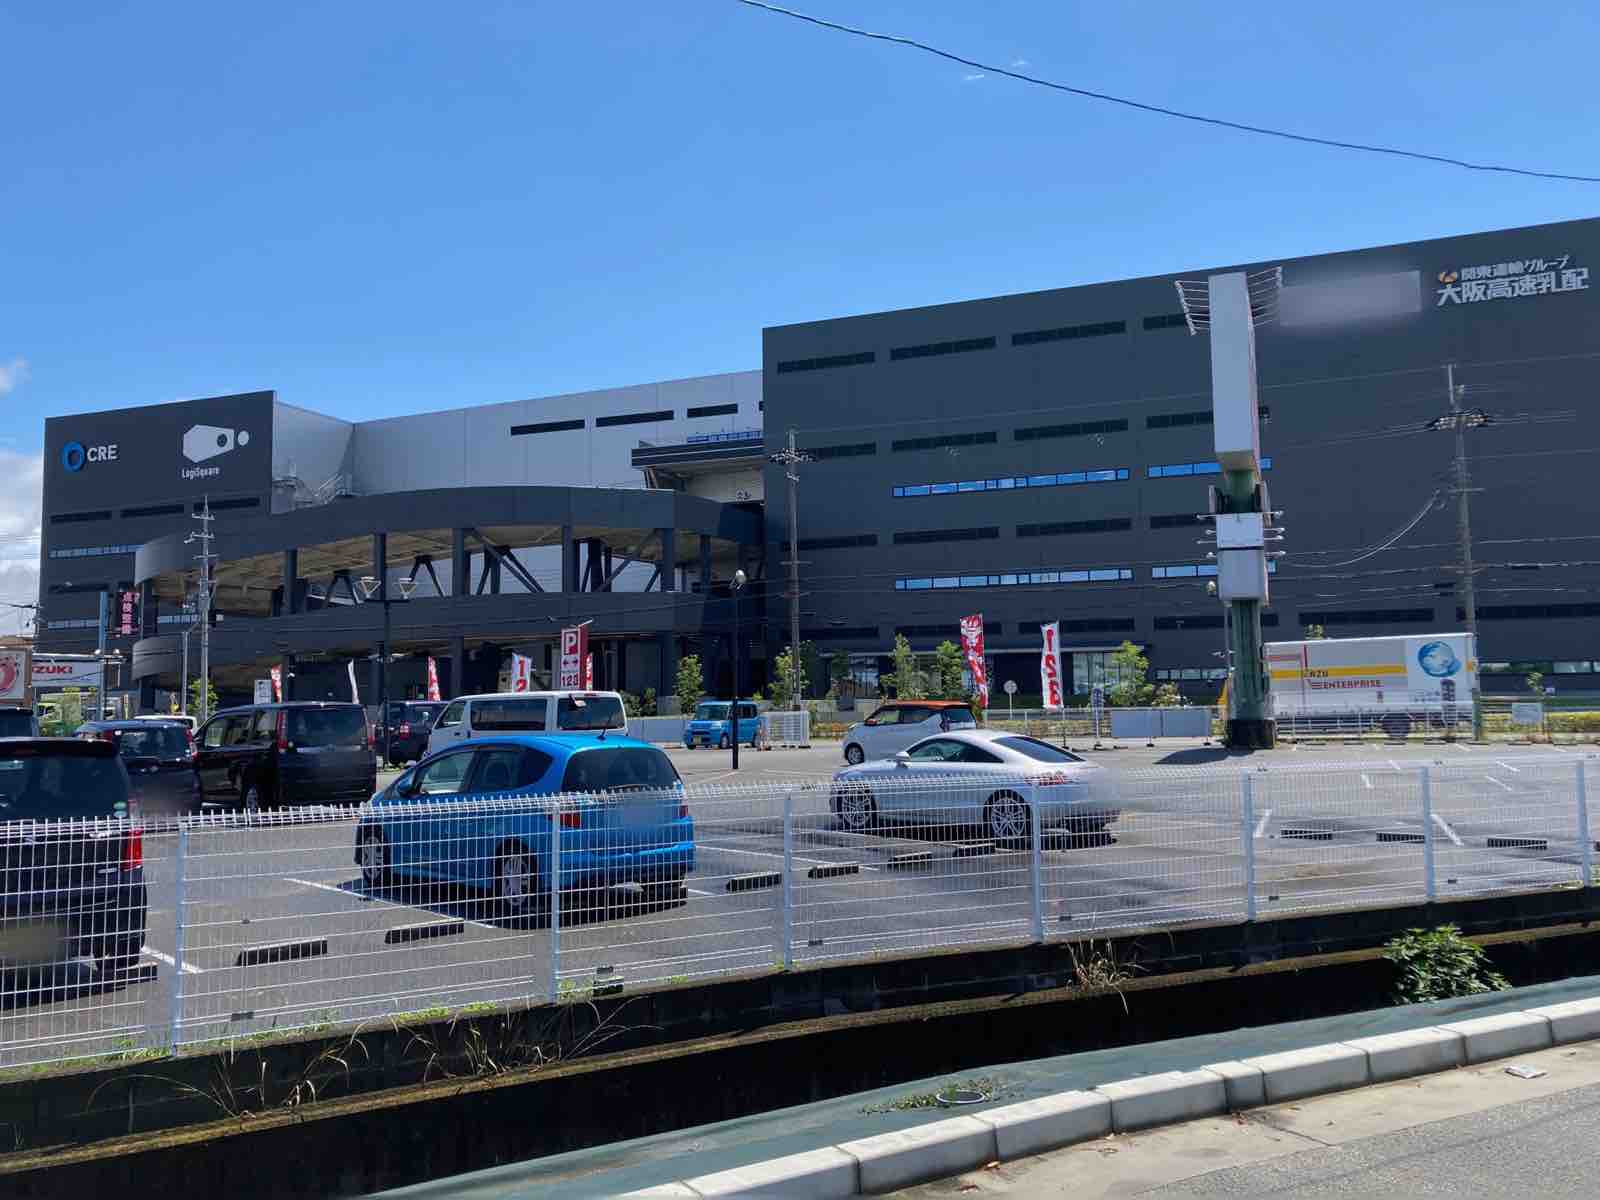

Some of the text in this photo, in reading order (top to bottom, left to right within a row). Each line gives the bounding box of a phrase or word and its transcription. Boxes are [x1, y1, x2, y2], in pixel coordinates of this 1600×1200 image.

[1437, 267, 1589, 306] 大阪高速乳配
[87, 444, 118, 462] CRE
[181, 466, 220, 480] LogiSquare
[565, 632, 578, 654] P
